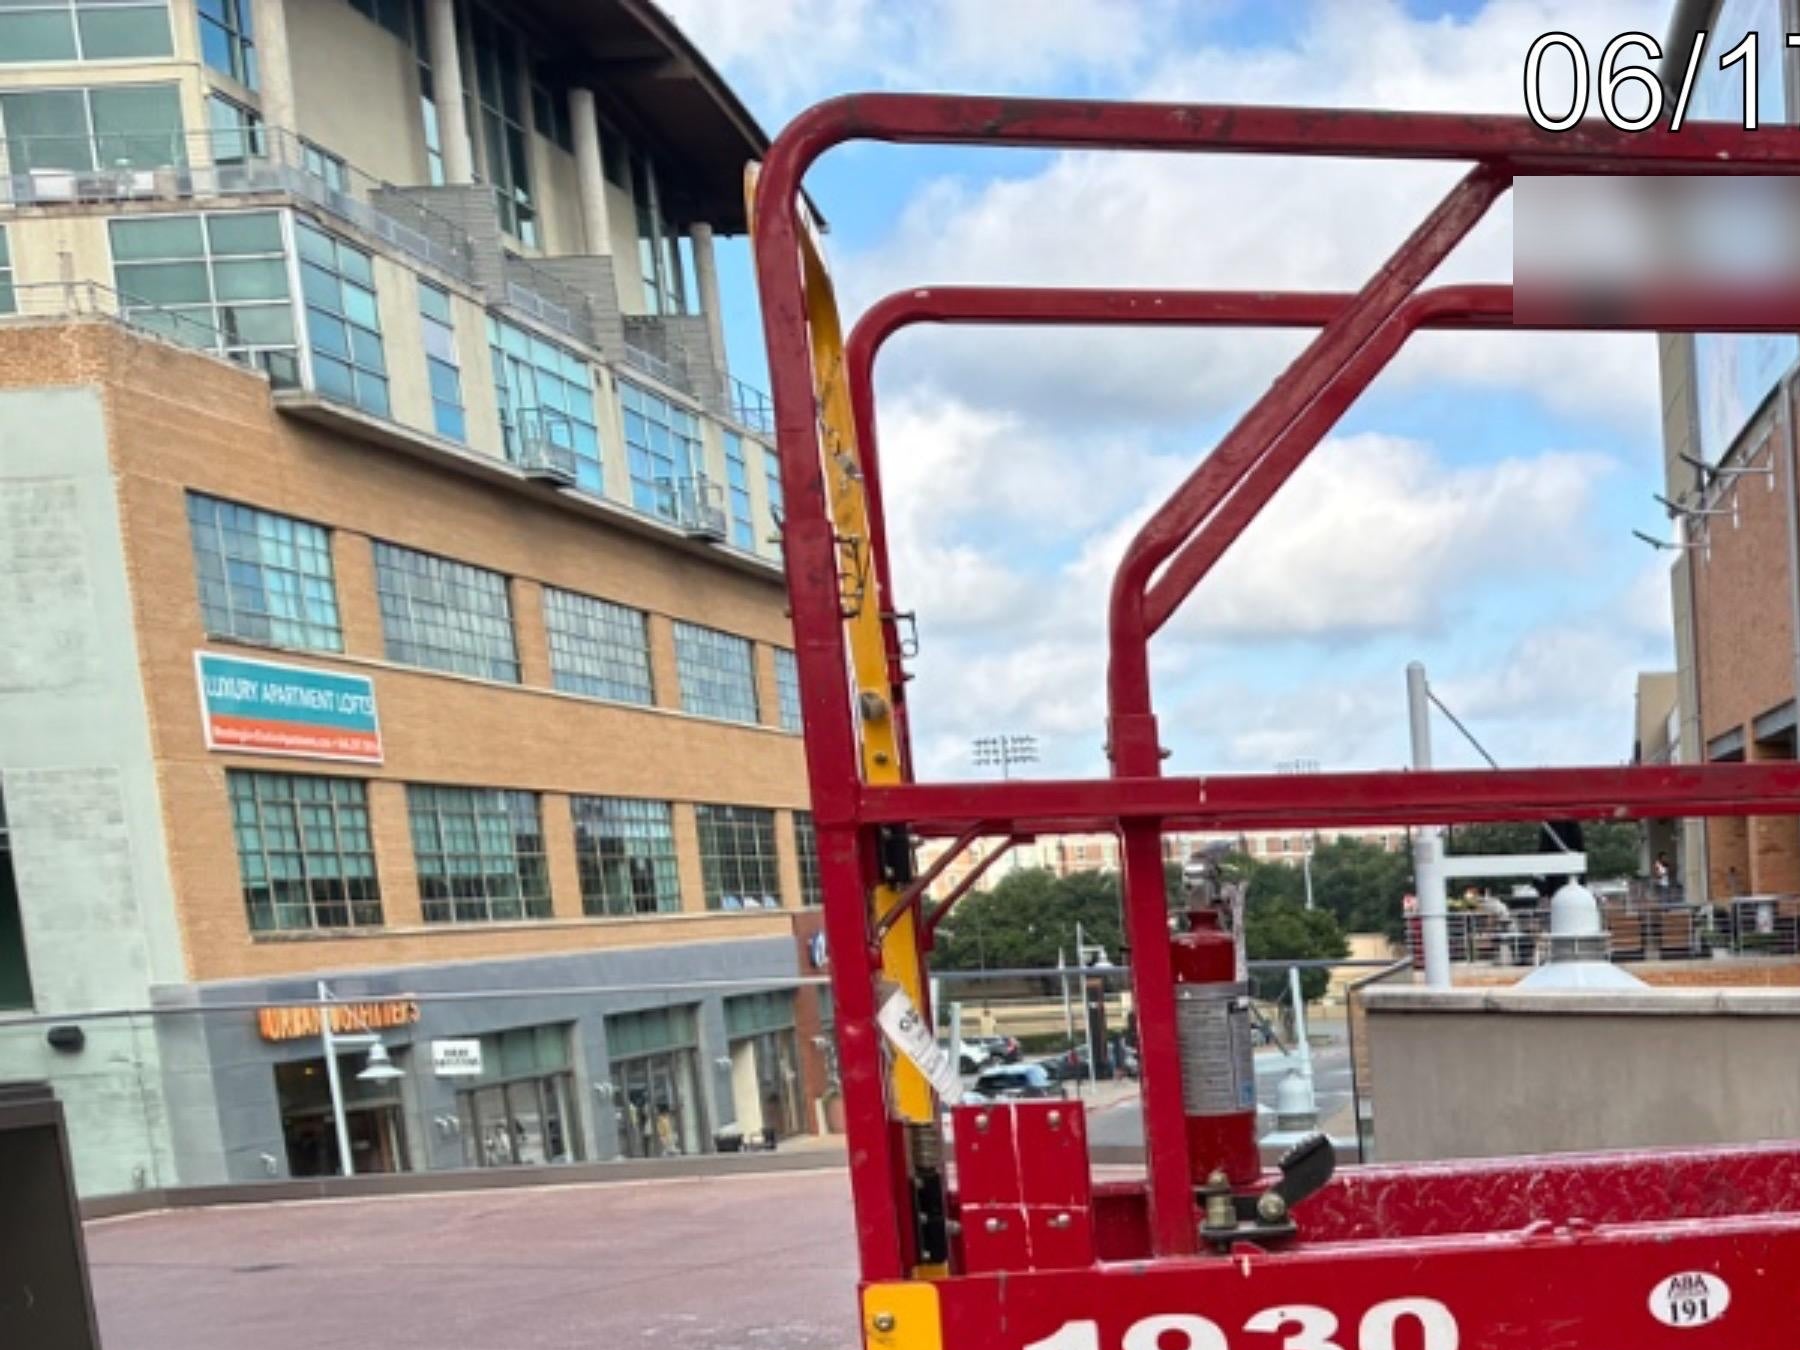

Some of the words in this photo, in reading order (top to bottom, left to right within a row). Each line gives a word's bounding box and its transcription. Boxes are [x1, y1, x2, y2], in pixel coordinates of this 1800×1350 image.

[206, 674, 258, 702] LUXURY
[260, 679, 334, 711] APARTMENT
[336, 692, 375, 716] LOFTS
[1671, 1298, 1708, 1323] 191
